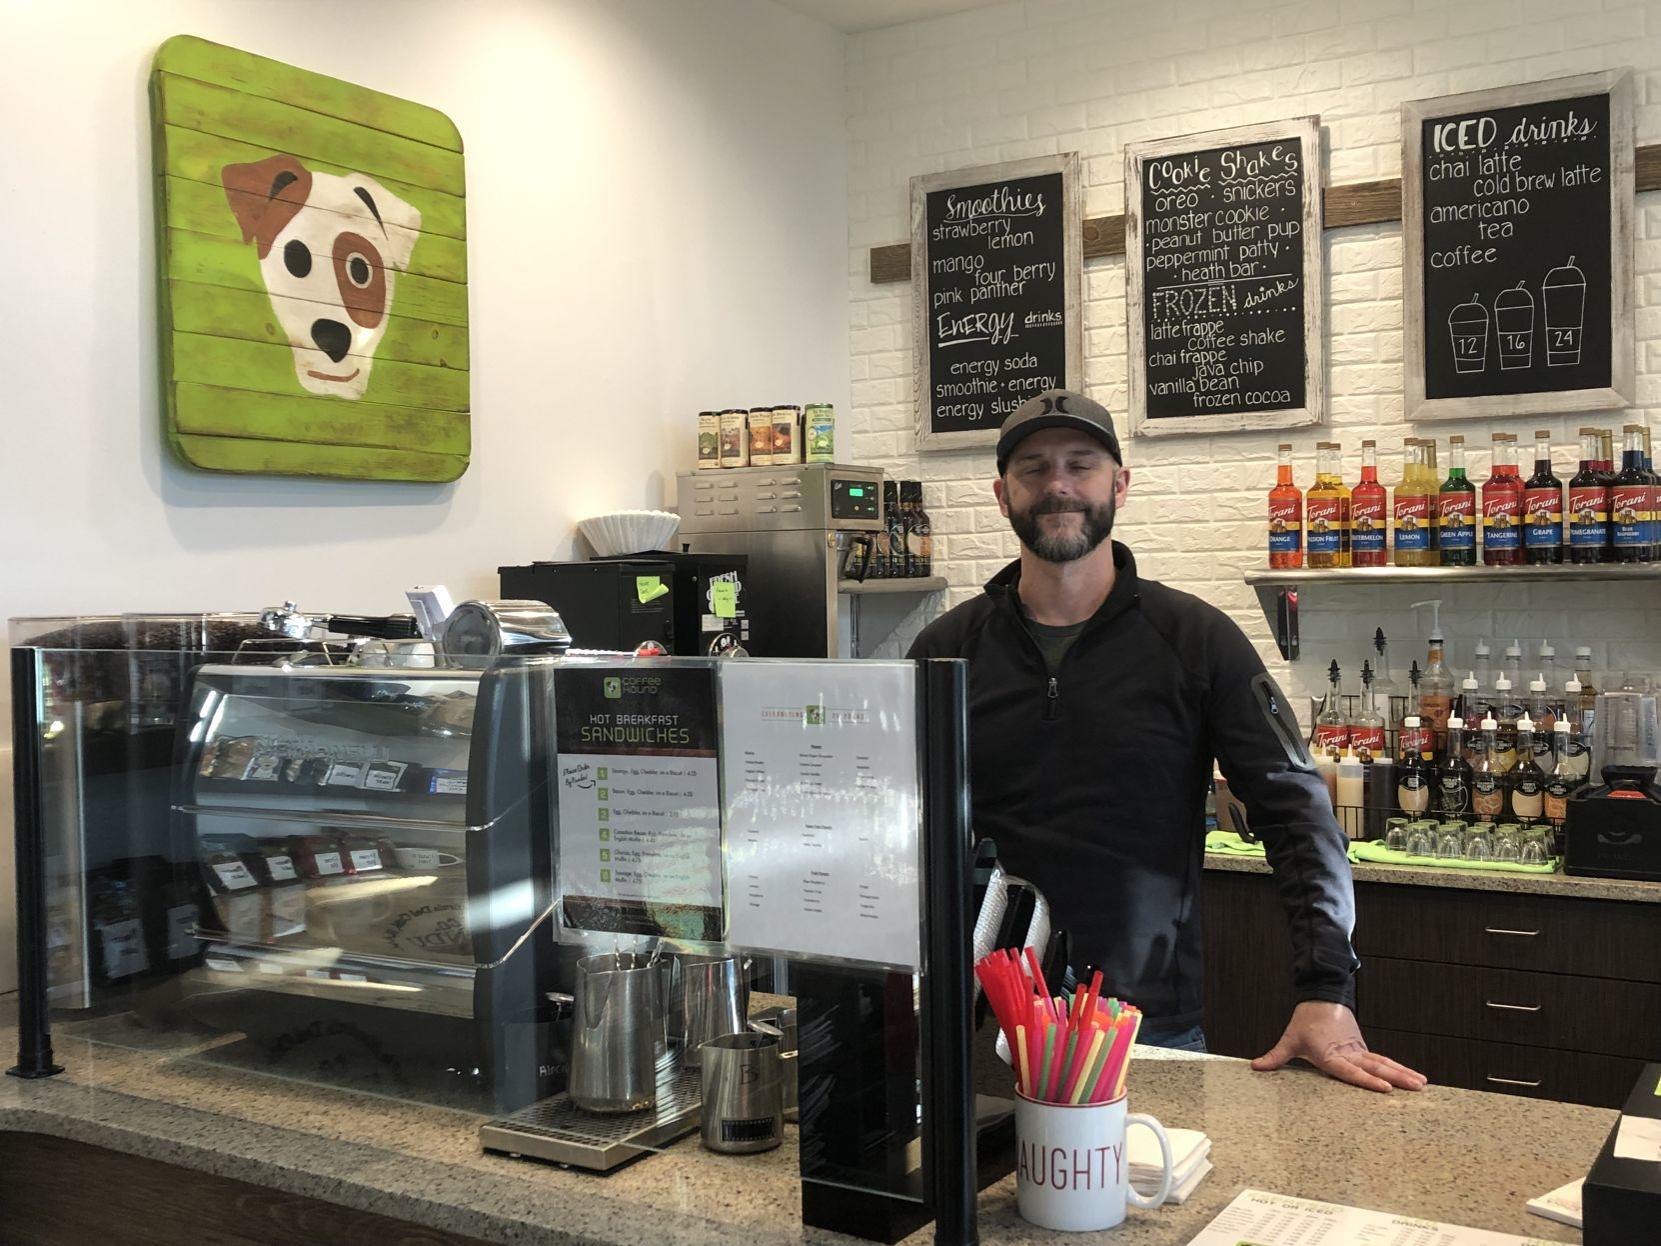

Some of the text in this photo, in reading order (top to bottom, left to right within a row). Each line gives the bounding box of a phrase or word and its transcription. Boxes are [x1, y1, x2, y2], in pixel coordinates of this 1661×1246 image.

[1434, 112, 1598, 152] ICED drinks
[1149, 145, 1298, 189] Cookie Shakes
[1429, 152, 1521, 180] chai latte
[1474, 166, 1602, 197] cold brew latte
[946, 186, 1046, 219] Smoothies
[1155, 180, 1296, 211] oreo snickers
[1147, 205, 1270, 234] monster cookie
[1430, 198, 1529, 223] americano
[933, 218, 1011, 241] strawberry
[988, 230, 1034, 250] lemon
[1152, 219, 1300, 253] peanut butter pup
[1479, 221, 1513, 240] tea
[933, 254, 984, 278] mango
[1147, 240, 1279, 272] peppermint patty
[1431, 246, 1497, 267] coffee
[975, 261, 1056, 286] four berry
[1182, 261, 1259, 281] heath bar
[934, 280, 1026, 309] pink panther
[1152, 278, 1299, 318] FROZEN drinks
[1024, 309, 1062, 325] drinks
[1151, 319, 1224, 340] latte frappe
[1188, 329, 1286, 351] coffee shake
[1554, 330, 1573, 347] 24
[1458, 337, 1477, 354] 12
[1507, 335, 1525, 350] 16
[950, 352, 1038, 377] energy soda
[1149, 349, 1227, 370] chai frappe
[1193, 357, 1264, 380] java chip
[936, 376, 1057, 398] smoothie energy
[1149, 376, 1239, 395] vanilla bean
[936, 395, 1031, 420] energy slush
[1193, 390, 1290, 408] frozen cocoa
[1352, 502, 1383, 520] Torani
[1394, 500, 1425, 519] Torani
[1440, 499, 1472, 516] Torani
[1485, 499, 1517, 518] Torani
[1526, 495, 1559, 514] Torani
[1570, 493, 1604, 513] Torani
[1612, 491, 1646, 512] Torani
[1307, 503, 1337, 522] Torani
[1532, 528, 1553, 536] GRAPE
[590, 714, 679, 726] HOT BREAKFAST
[581, 726, 690, 744] SANDWICHES
[1351, 732, 1380, 748] Torani
[1018, 1139, 1123, 1190] AUGHTY
[1251, 1197, 1277, 1206] HOT
